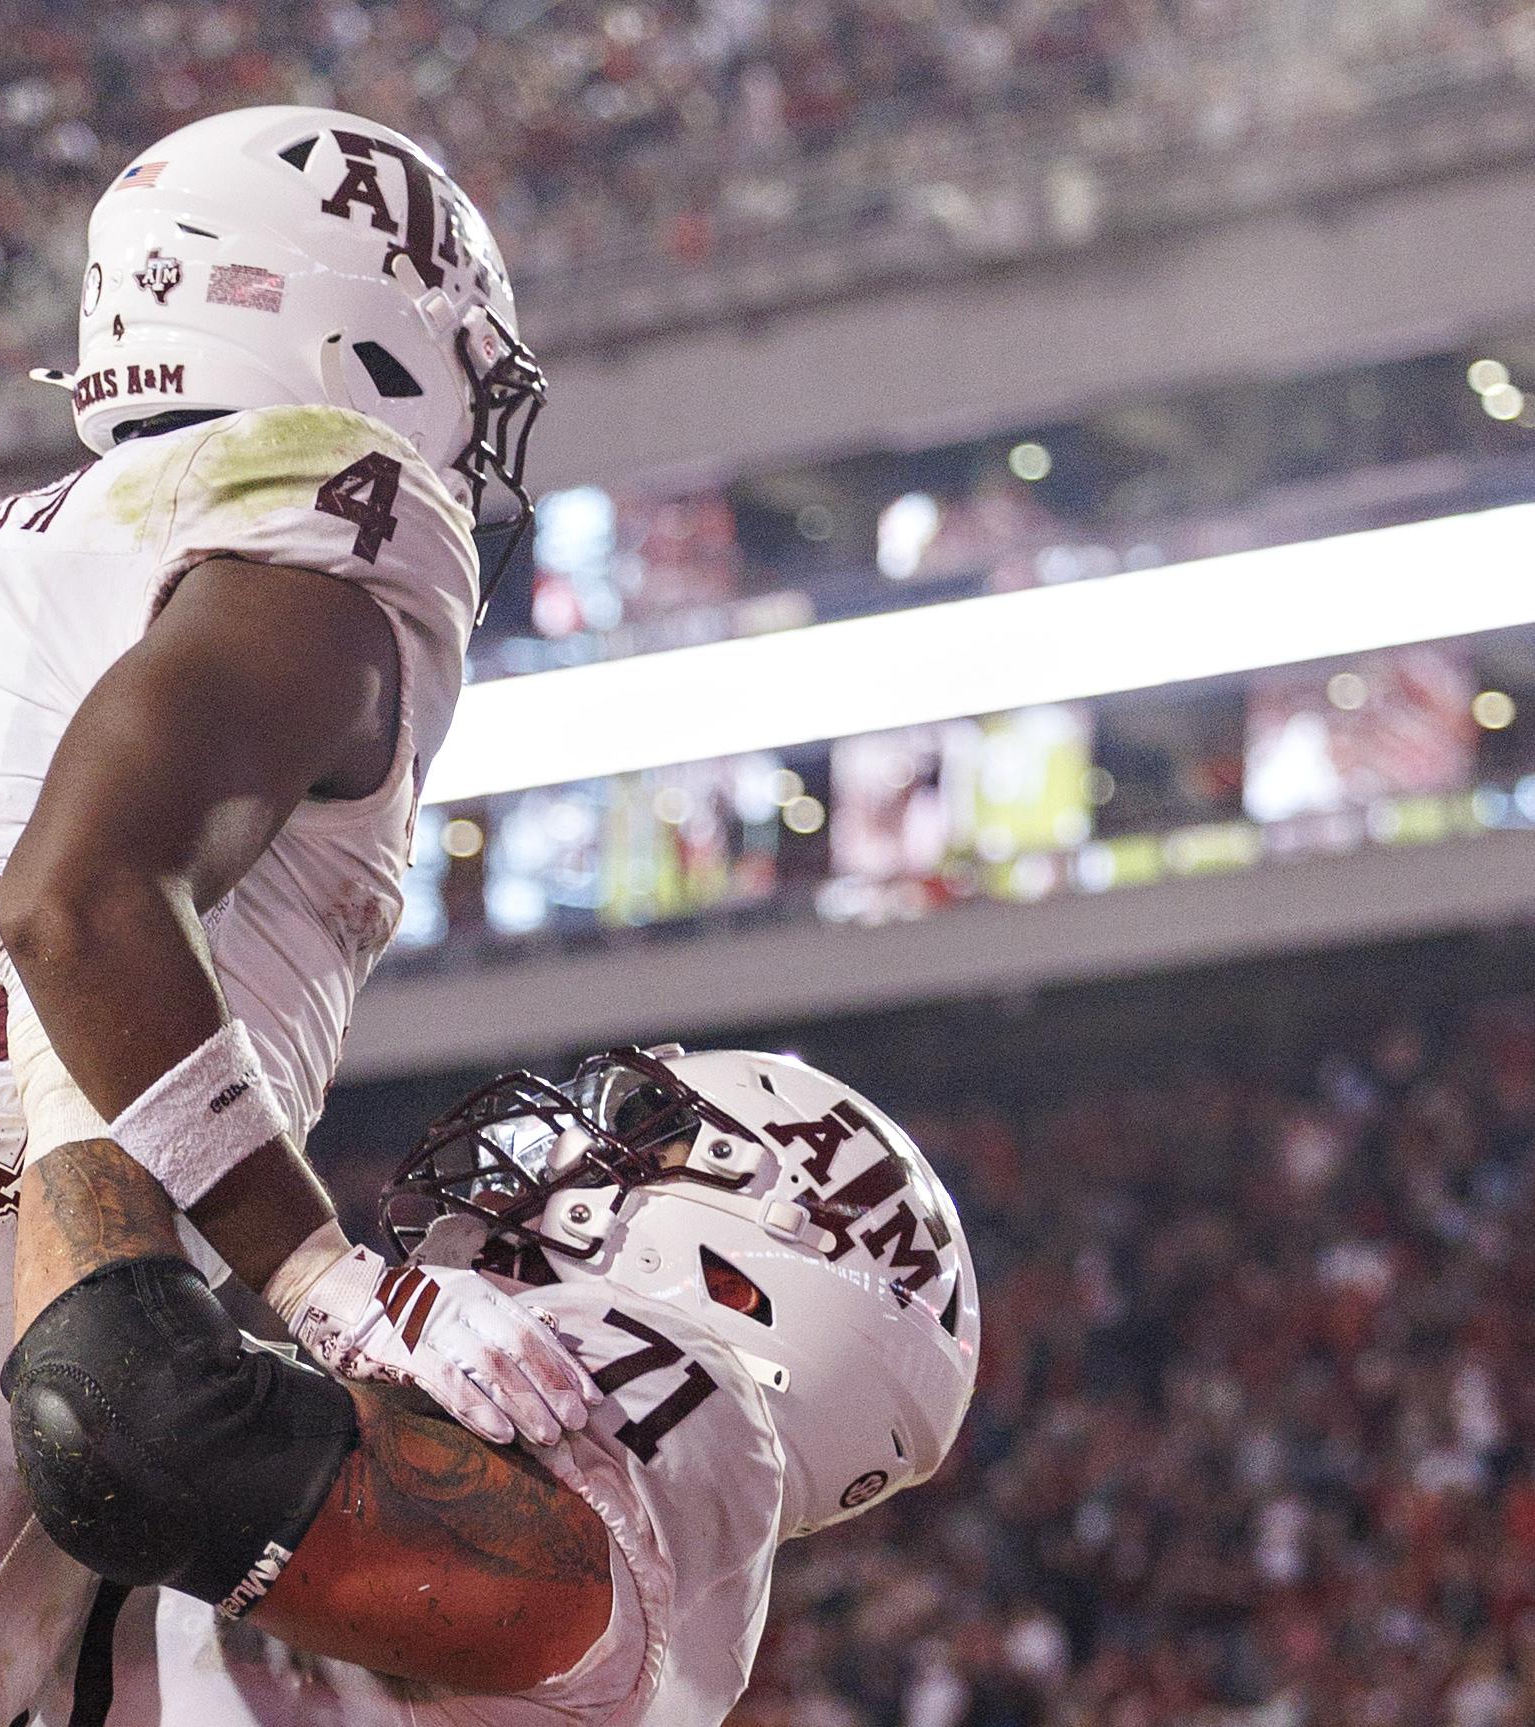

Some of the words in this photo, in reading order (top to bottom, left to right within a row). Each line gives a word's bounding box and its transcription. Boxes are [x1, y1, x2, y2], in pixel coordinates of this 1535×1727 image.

[74, 368, 119, 415] EXAS
[127, 364, 185, 394] A&M
[314, 450, 403, 566] 4
[589, 1306, 719, 1467] 71
